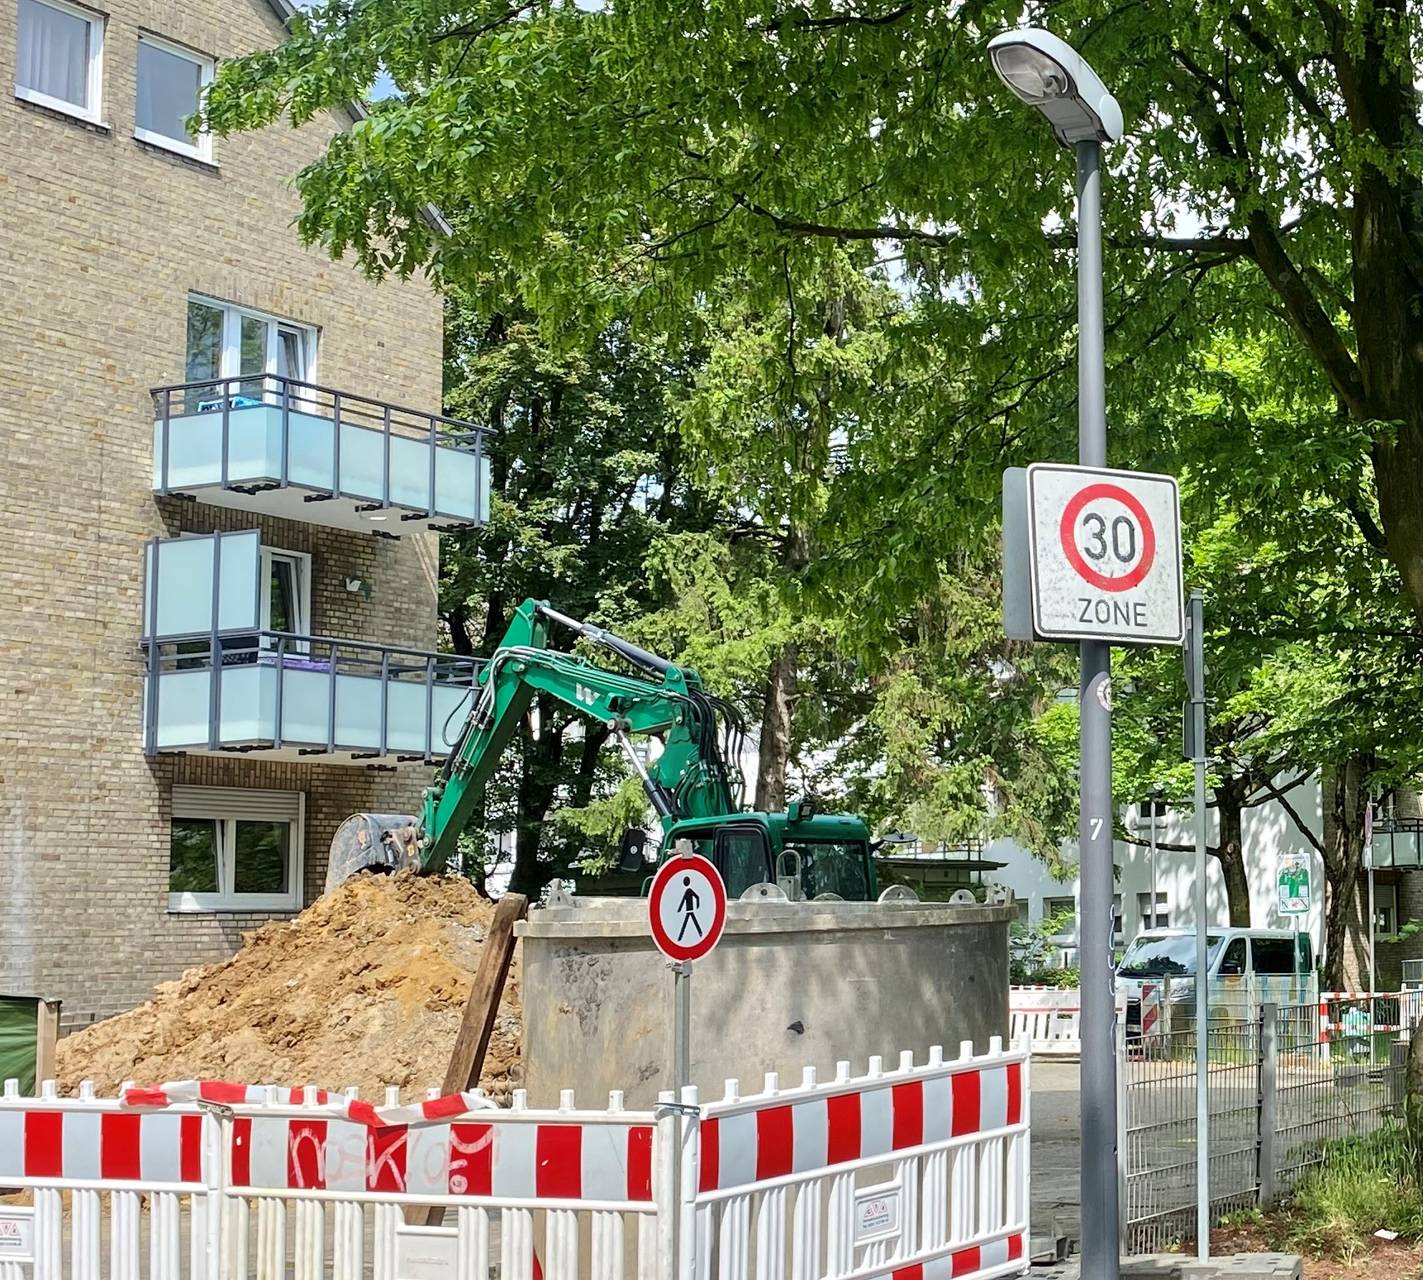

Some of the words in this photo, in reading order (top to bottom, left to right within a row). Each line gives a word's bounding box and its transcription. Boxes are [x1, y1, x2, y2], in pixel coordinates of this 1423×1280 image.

[1082, 512, 1136, 563] 30
[1078, 598, 1148, 627] ZONE
[1089, 818, 1104, 841] 7
